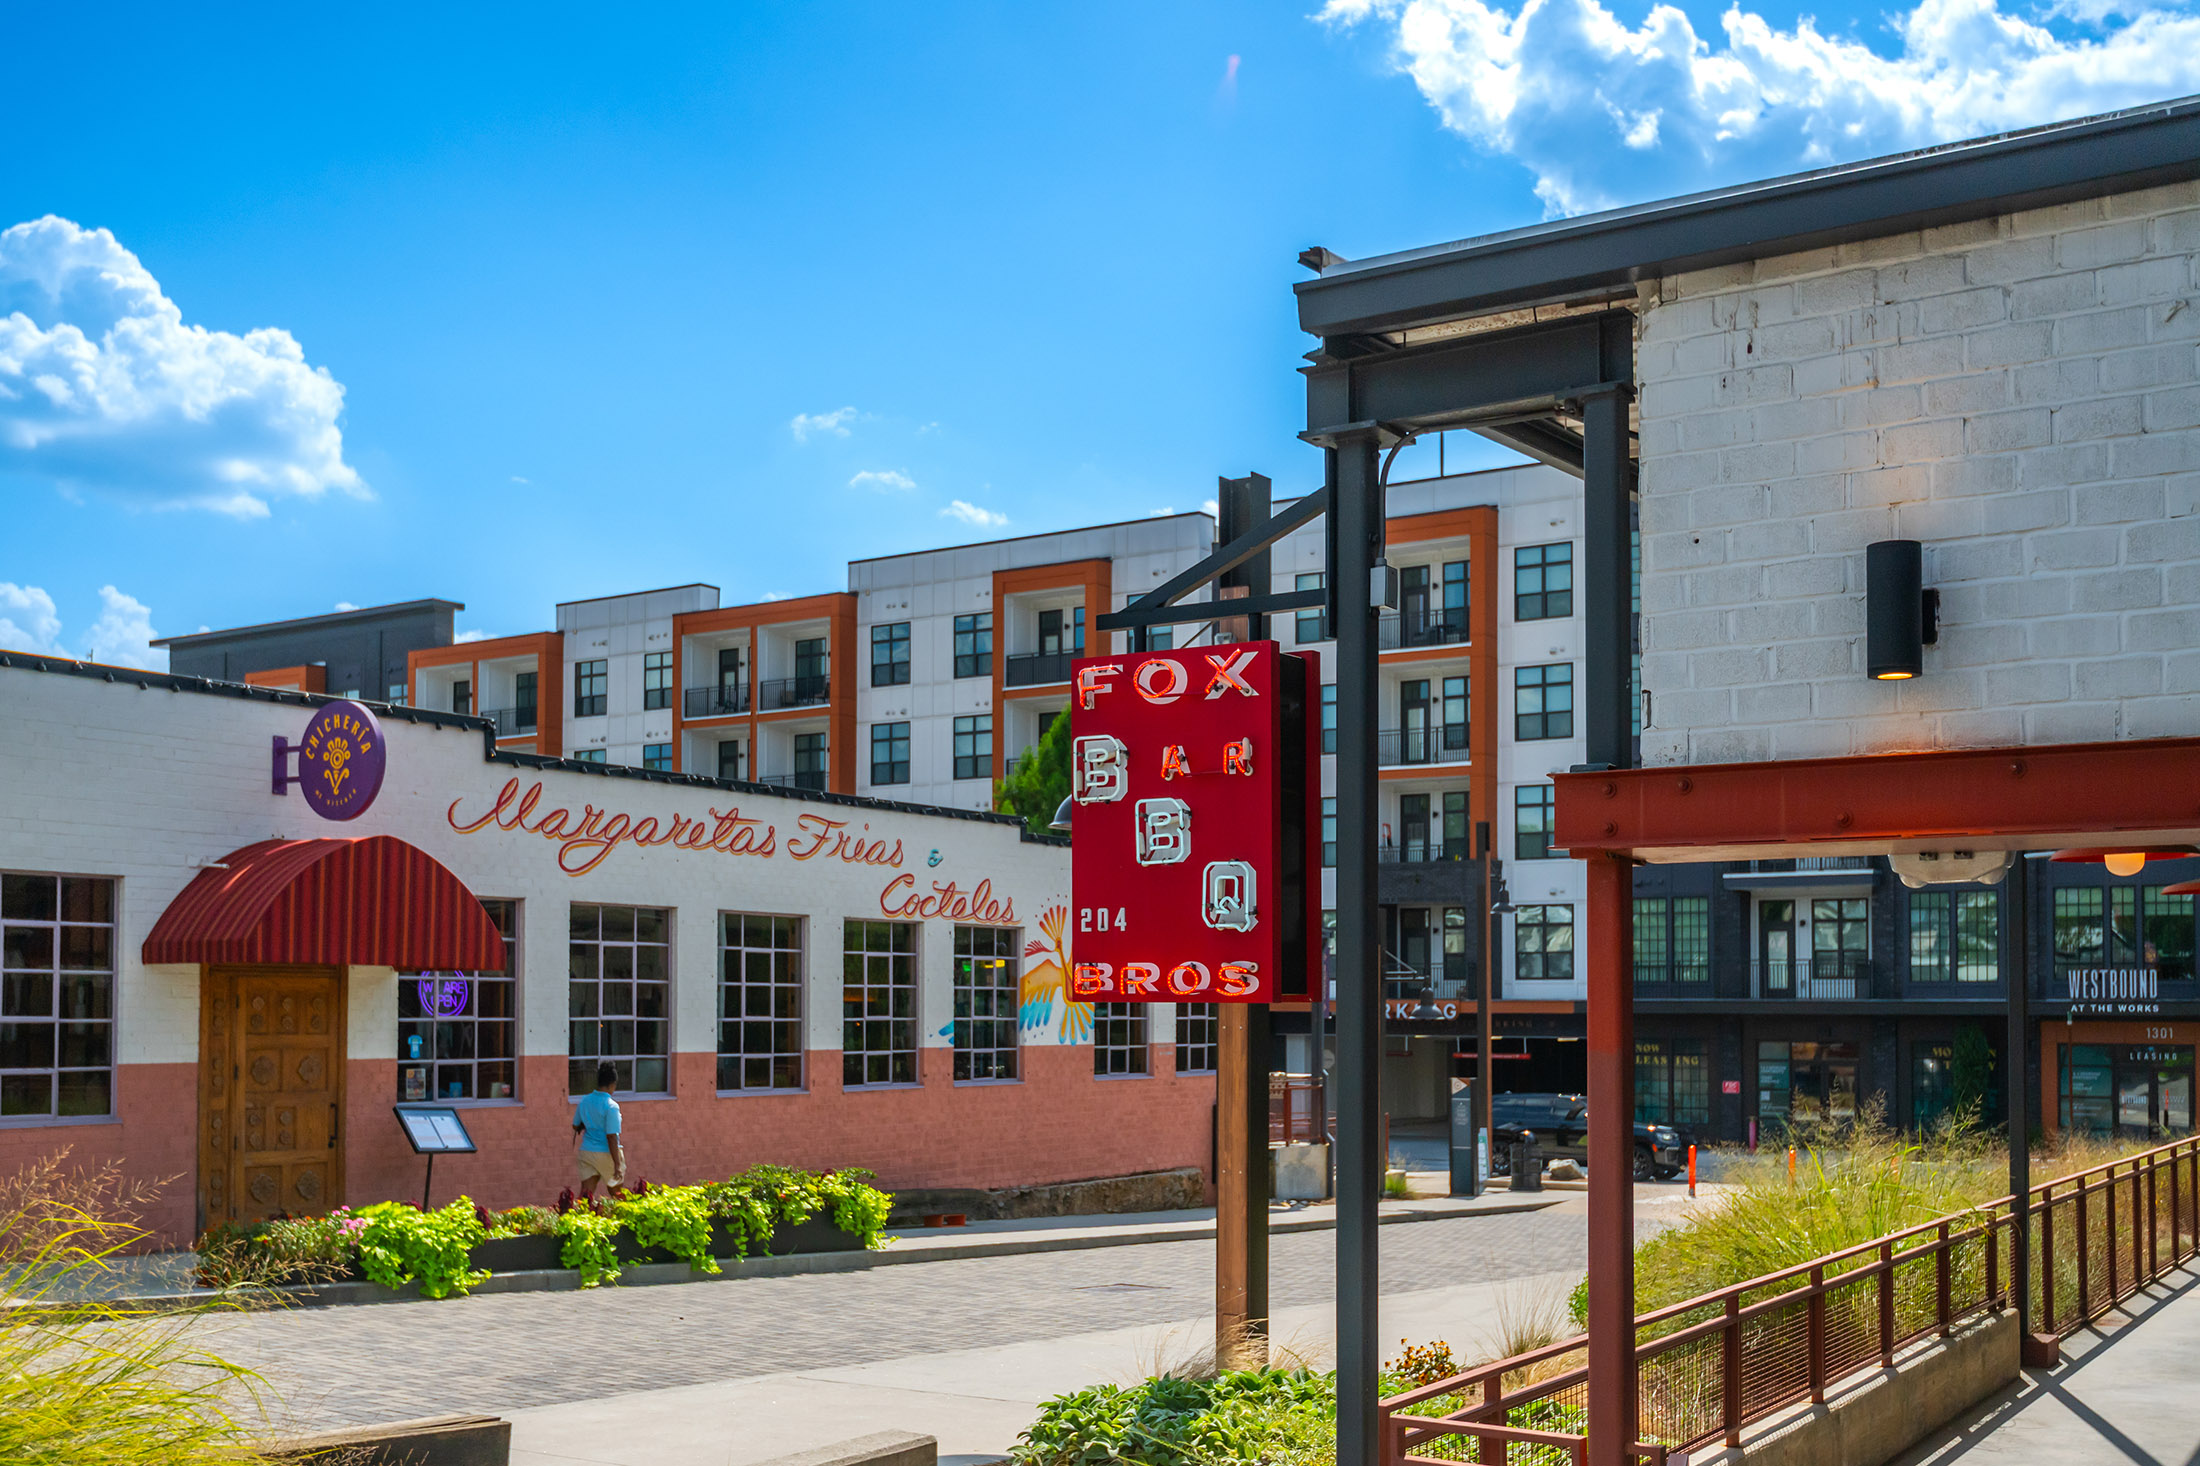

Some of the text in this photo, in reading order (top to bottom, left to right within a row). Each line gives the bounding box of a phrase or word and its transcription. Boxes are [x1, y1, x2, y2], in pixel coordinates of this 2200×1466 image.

[1077, 649, 1260, 710] FOX
[305, 713, 372, 760] CHICHERÍA
[879, 872, 1024, 925] Cocteles
[1080, 906, 1128, 933] 204
[1073, 960, 1260, 997] BROS
[2067, 968, 2158, 1000] WESTBOUND
[2070, 1003, 2160, 1013] AT THE WORKS
[2146, 1027, 2174, 1040] 1301
[1635, 1044, 1660, 1053] NOW
[2129, 1052, 2178, 1061] LEASING
